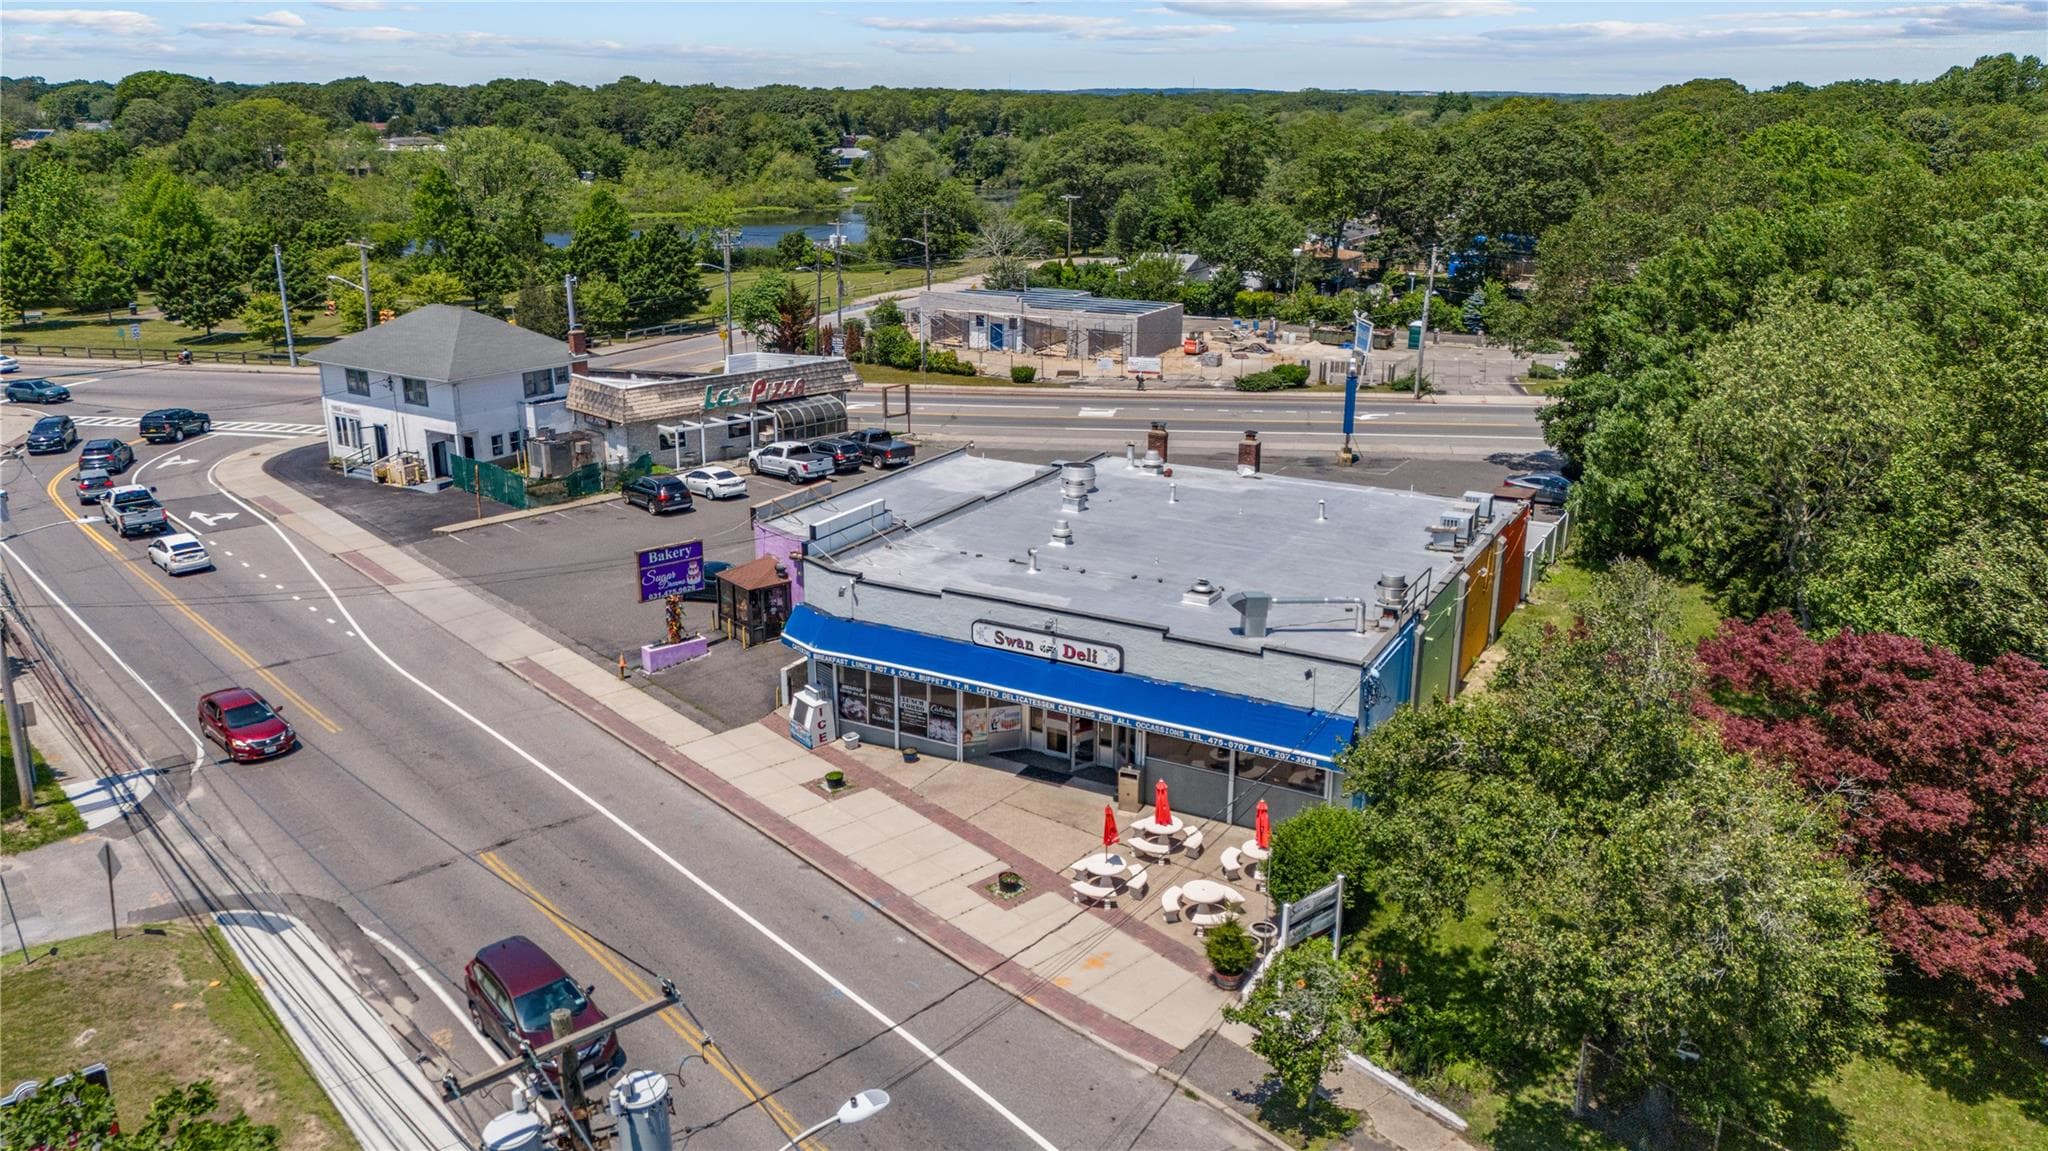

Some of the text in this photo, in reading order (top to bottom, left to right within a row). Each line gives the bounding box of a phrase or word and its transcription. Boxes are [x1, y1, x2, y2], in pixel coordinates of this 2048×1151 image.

[648, 546, 692, 564] Bakery
[642, 569, 677, 588] Sugar
[994, 630, 1098, 664] Swan Deli
[813, 653, 848, 665] BREAKFAST
[851, 660, 872, 671] LUNCH
[875, 665, 887, 674] HOT
[890, 667, 896, 675] &
[898, 670, 916, 680] COLD
[919, 673, 945, 685] BUFFET
[976, 687, 999, 698] LOTTO
[1002, 692, 1055, 710] DELICATESSEN
[1058, 704, 1095, 718] CATERING
[1098, 713, 1113, 722] FOR
[1117, 717, 1132, 726] ALL
[1135, 721, 1185, 737] OCCASSIONS
[817, 707, 828, 743] ICE
